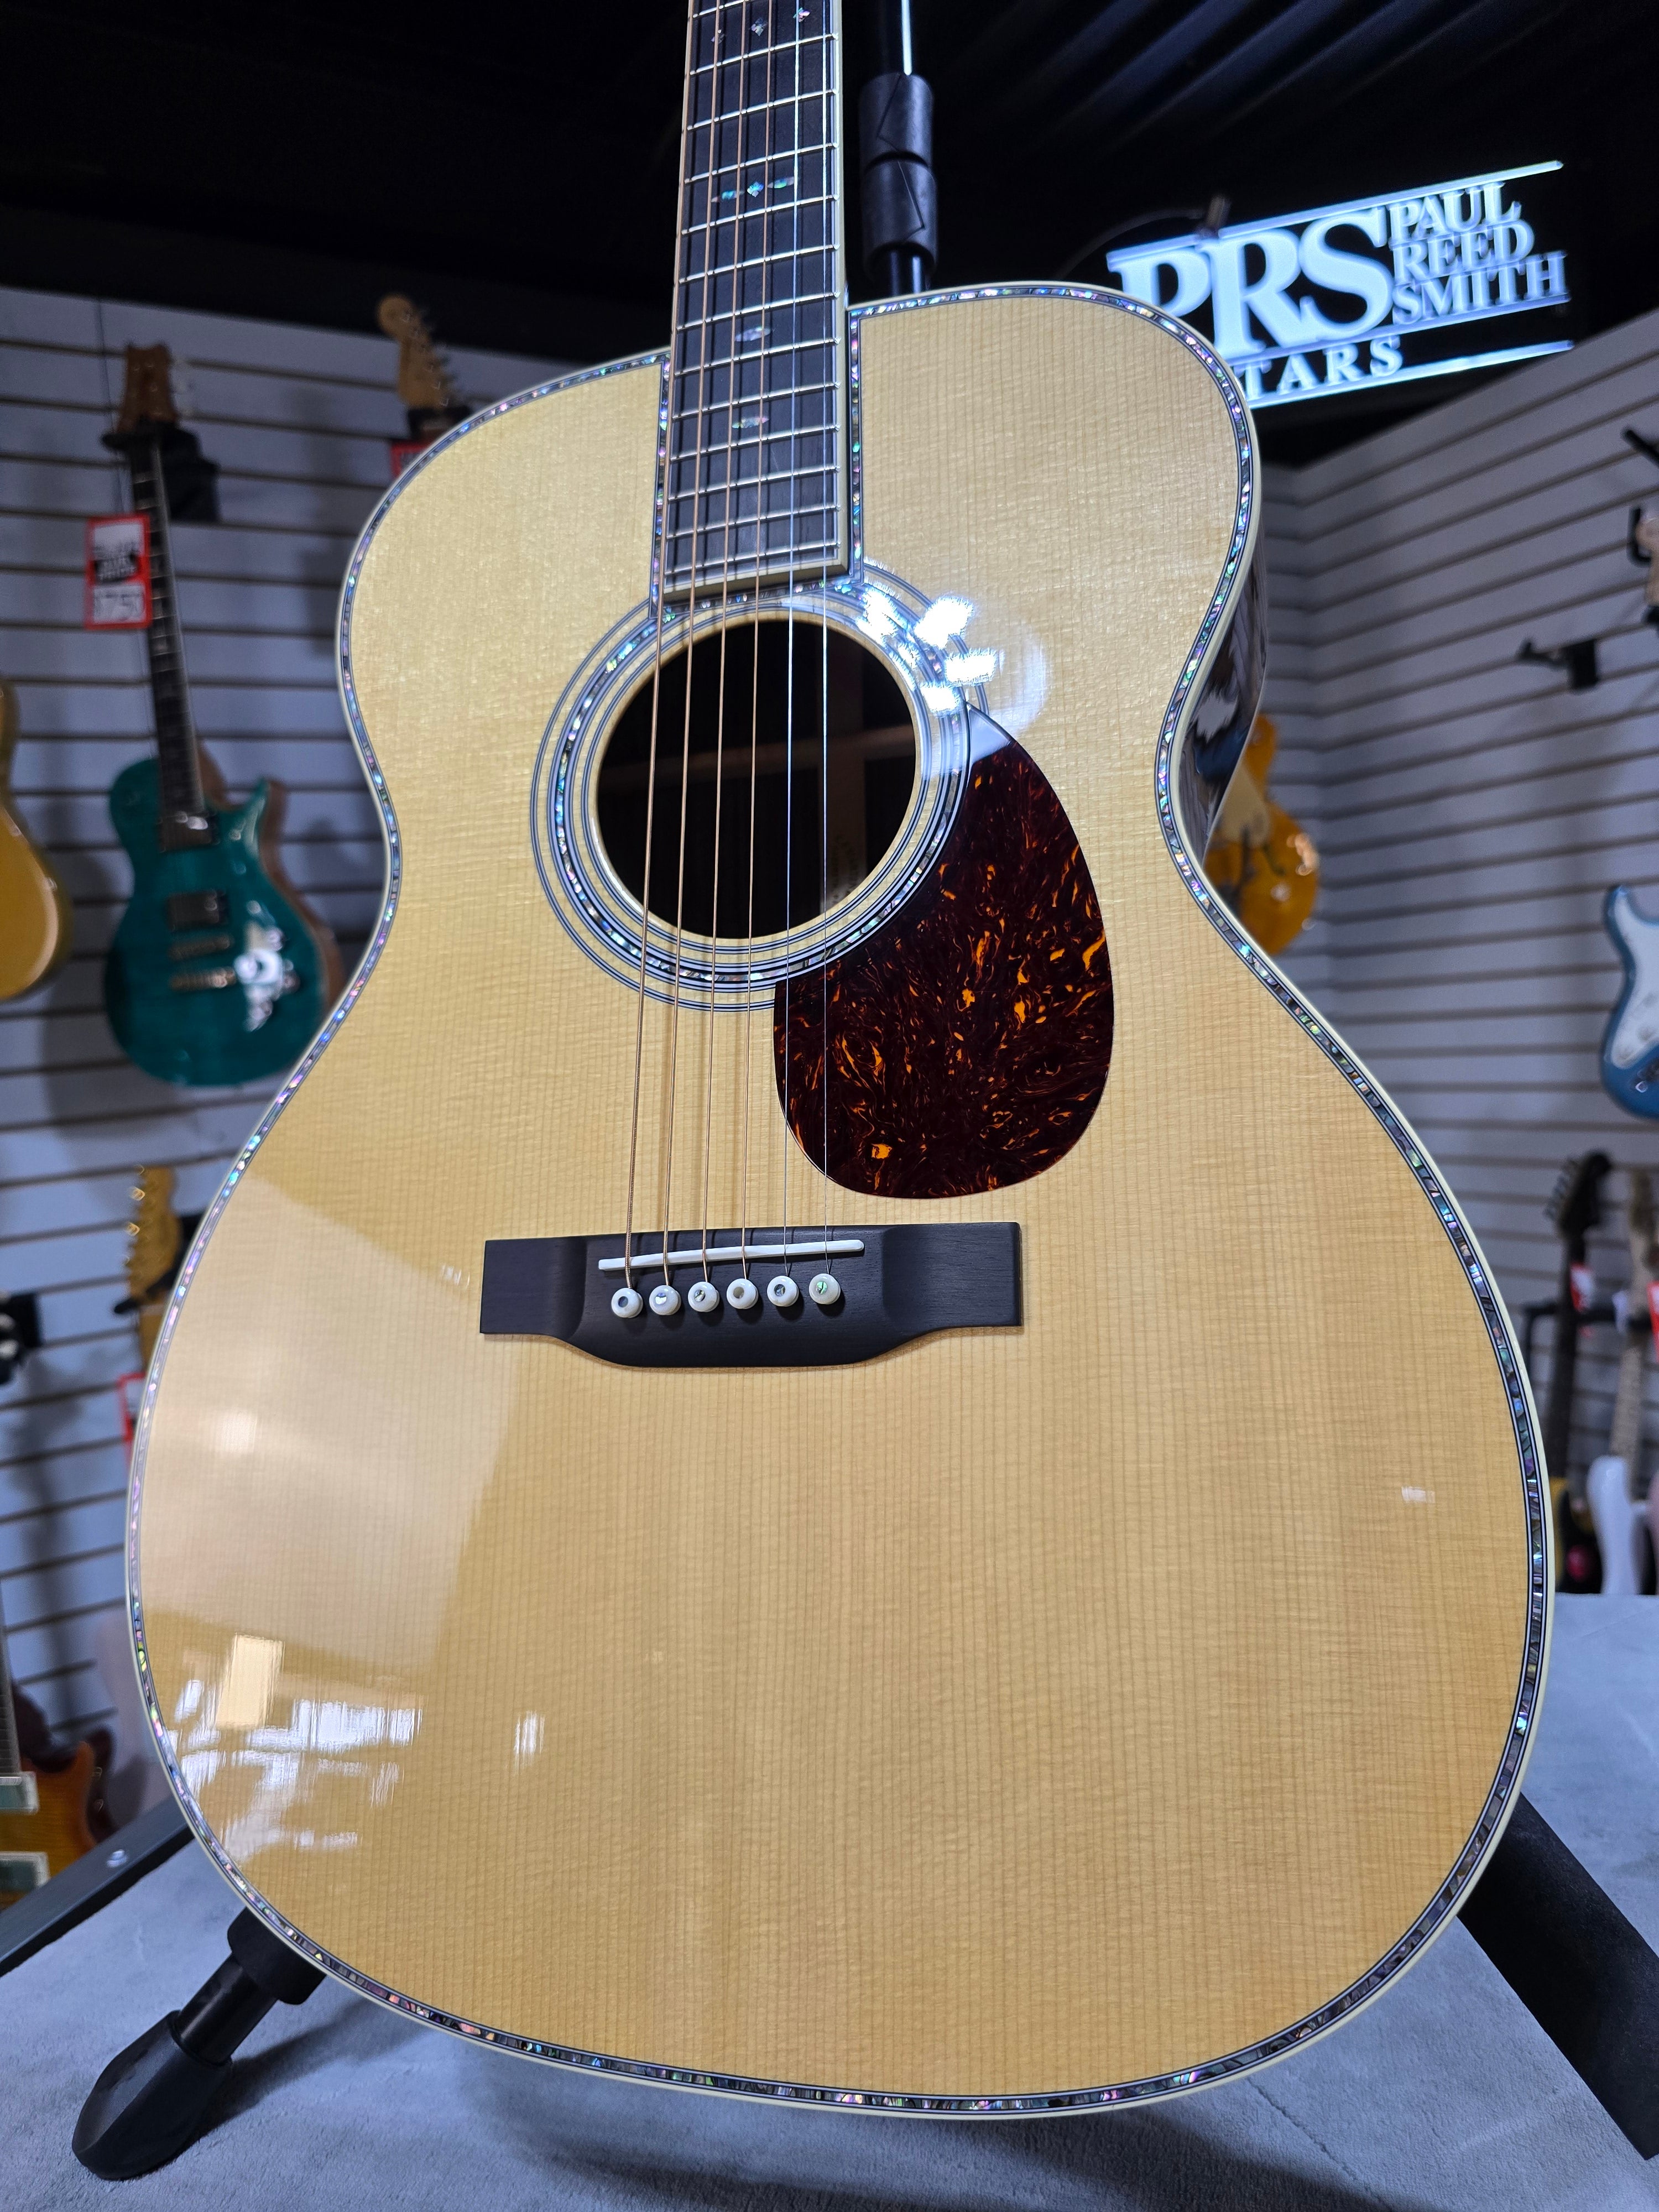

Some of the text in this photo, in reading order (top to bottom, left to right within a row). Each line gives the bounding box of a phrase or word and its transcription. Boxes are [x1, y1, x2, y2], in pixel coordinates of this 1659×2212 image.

[1386, 181, 1522, 249] PAUL
[1108, 204, 1394, 359] PRS
[1389, 220, 1535, 288] REED
[1391, 250, 1568, 325] SMITH
[1233, 335, 1404, 400] TARS
